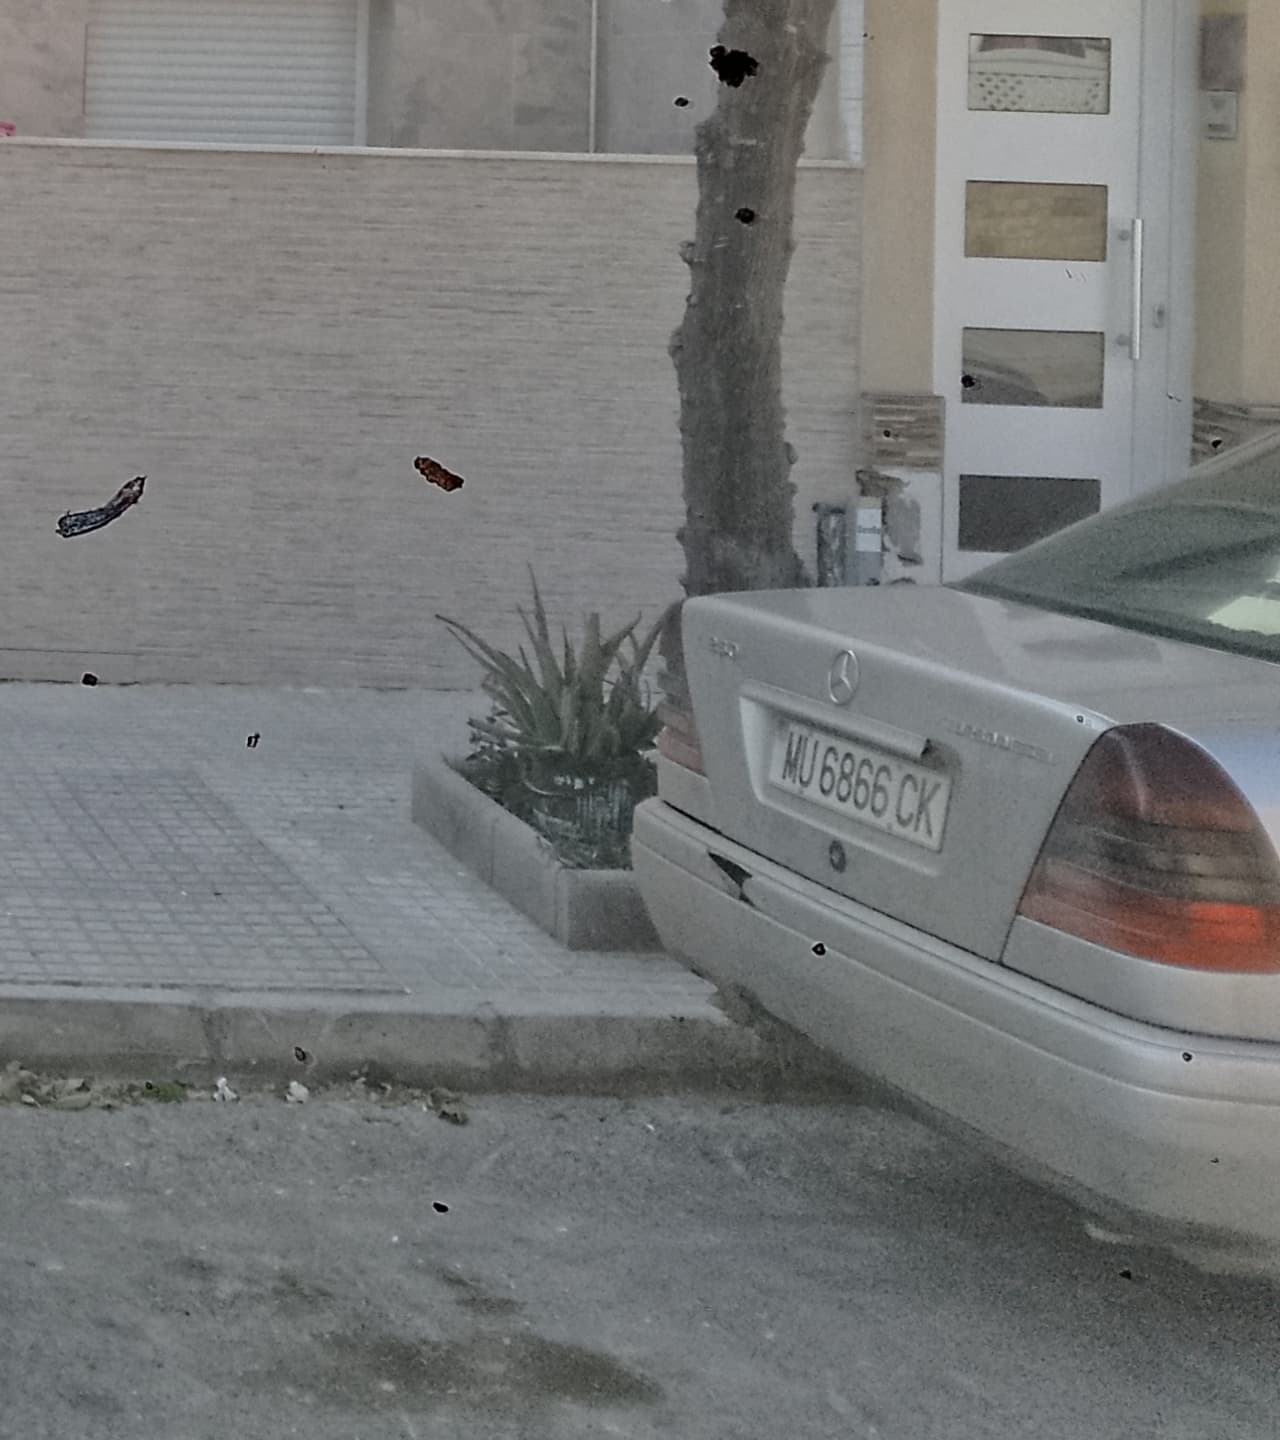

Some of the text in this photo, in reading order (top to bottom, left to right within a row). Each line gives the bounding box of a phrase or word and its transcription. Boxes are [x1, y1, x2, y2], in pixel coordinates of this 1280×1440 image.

[782, 731, 941, 839] MU 6866 CK
